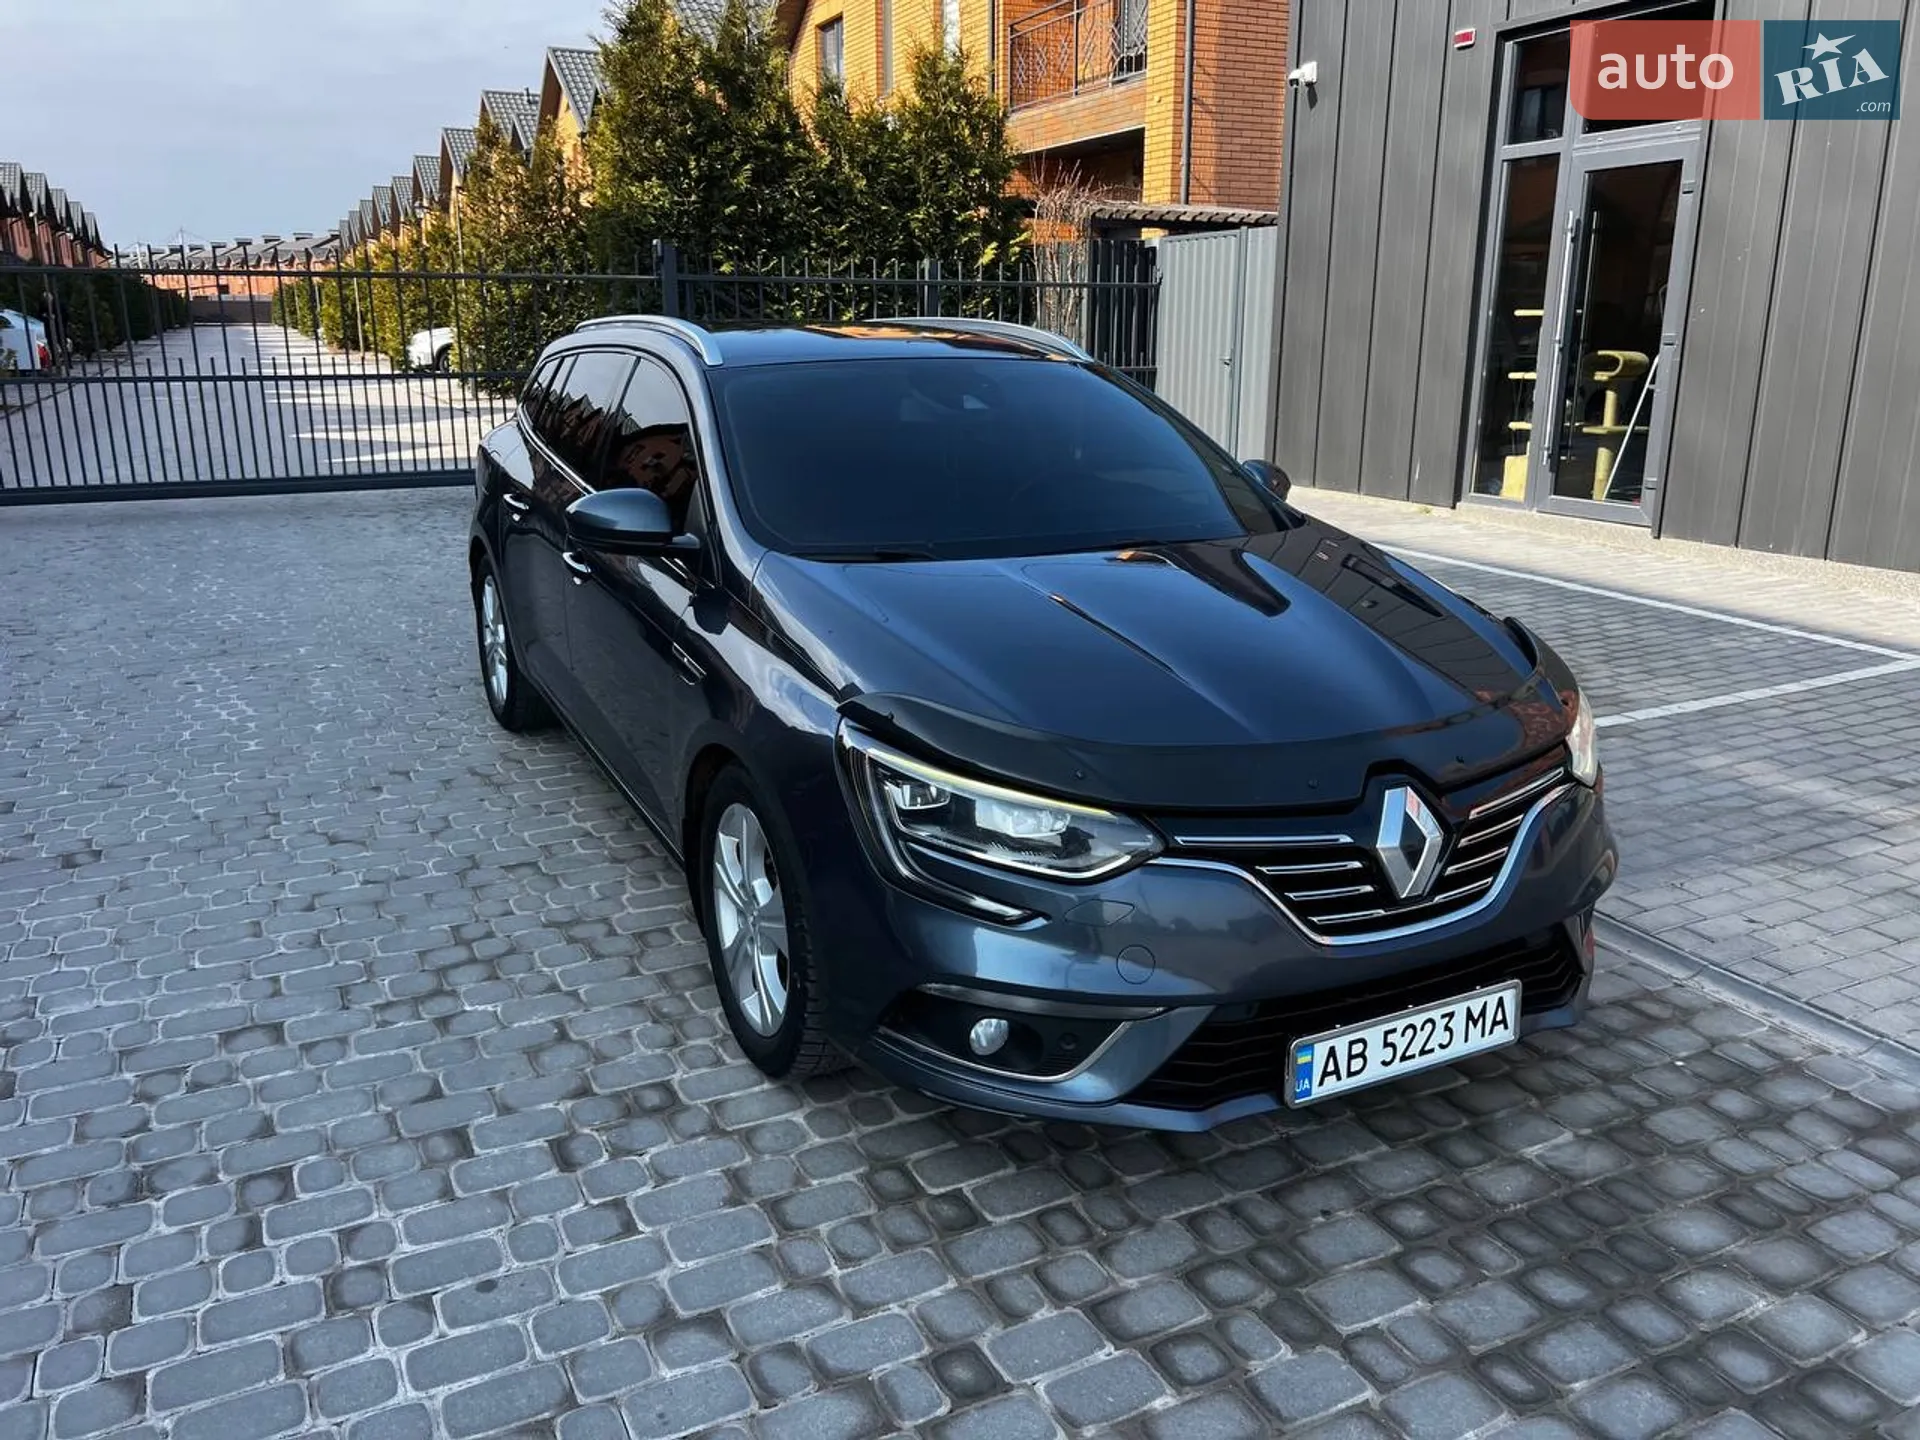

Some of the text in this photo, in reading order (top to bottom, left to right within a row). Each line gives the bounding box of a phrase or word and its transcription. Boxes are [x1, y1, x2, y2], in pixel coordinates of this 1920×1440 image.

[1318, 996, 1509, 1088] AB 5223 MA
[1294, 1078, 1311, 1092] UA
